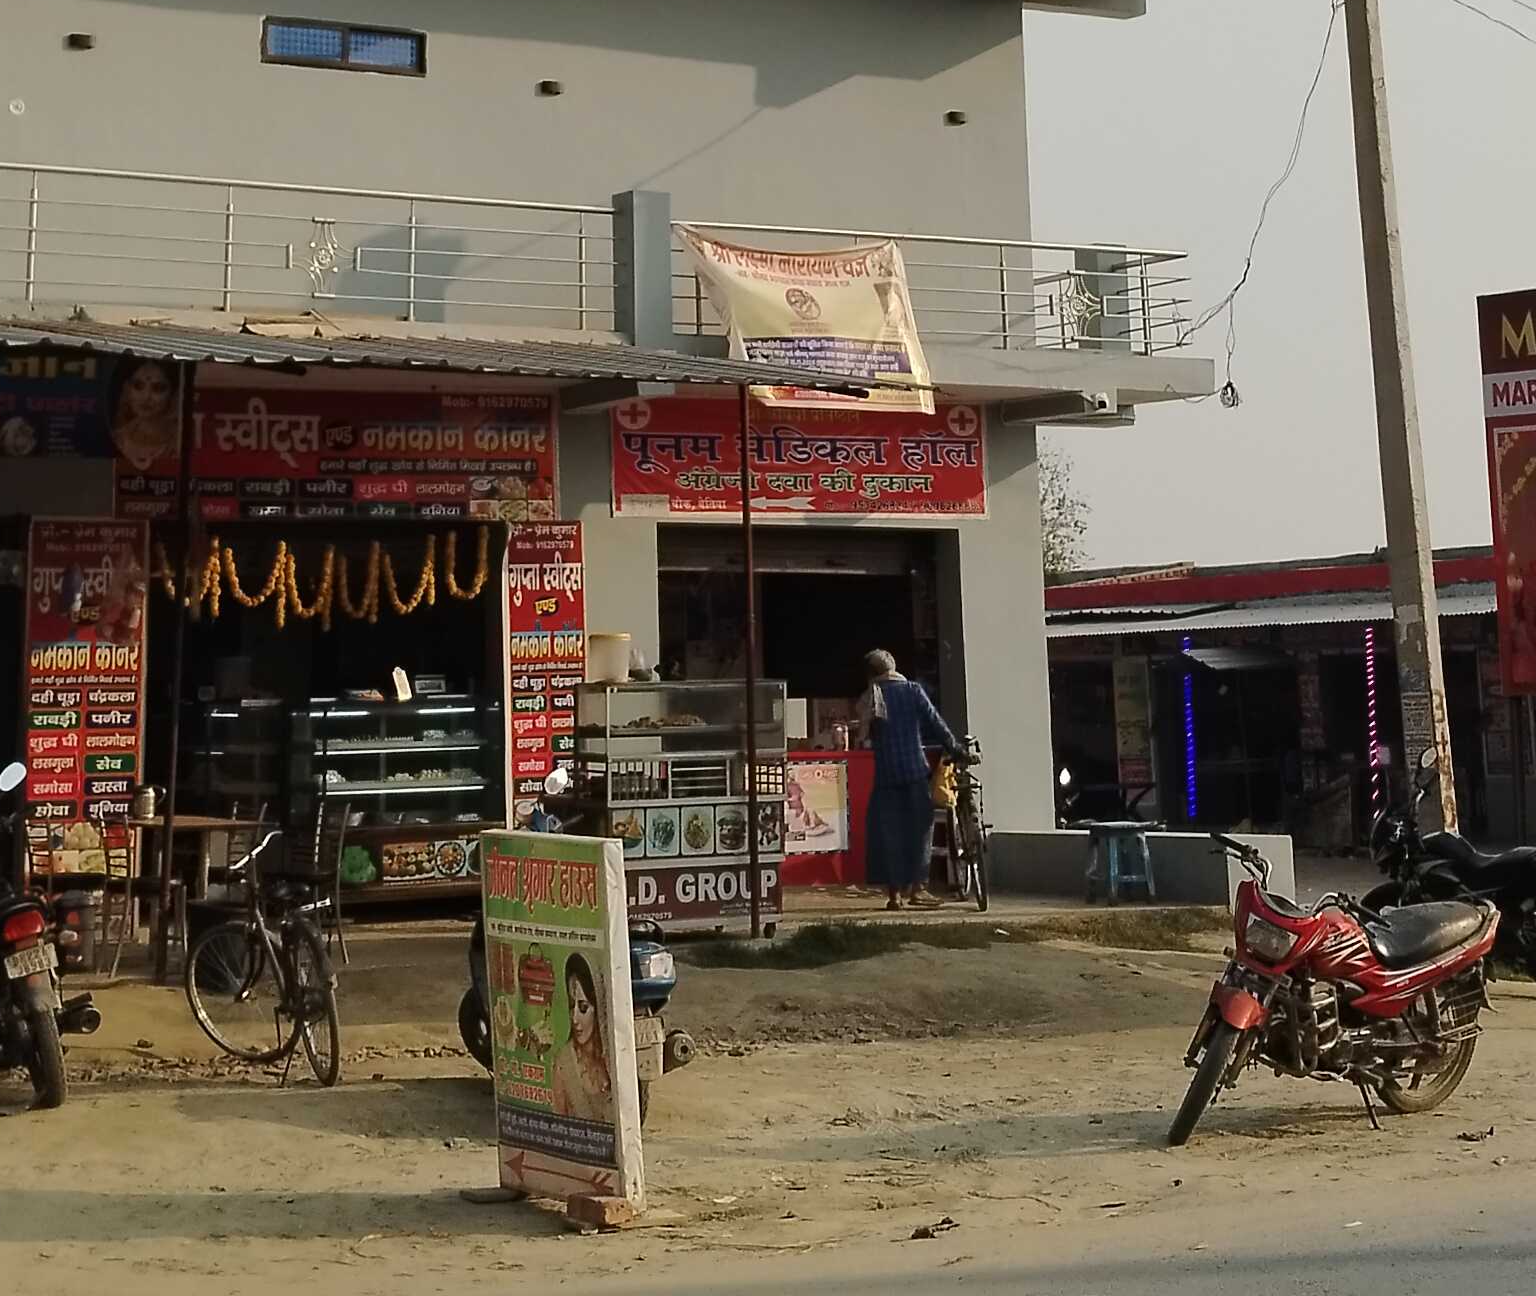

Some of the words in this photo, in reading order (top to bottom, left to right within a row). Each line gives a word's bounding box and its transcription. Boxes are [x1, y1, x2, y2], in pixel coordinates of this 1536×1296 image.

[621, 432, 724, 474] पूनम
[736, 424, 889, 466] मेडिकल
[899, 430, 980, 471] हॉल
[766, 472, 814, 492] दवा
[819, 467, 857, 493] की
[859, 474, 934, 499] दुकान
[509, 563, 540, 607] गुप्ता
[543, 551, 582, 601] स्वीट्स
[32, 690, 54, 703] दही
[89, 689, 136, 703] चंद्रकला
[553, 694, 575, 707] पनी
[91, 710, 132, 724] पनीर
[86, 734, 136, 747] लालमोहन
[96, 756, 123, 770] सेव
[33, 781, 73, 795] समोसा
[92, 781, 128, 793] खस्ता
[675, 870, 777, 903] GROUP
